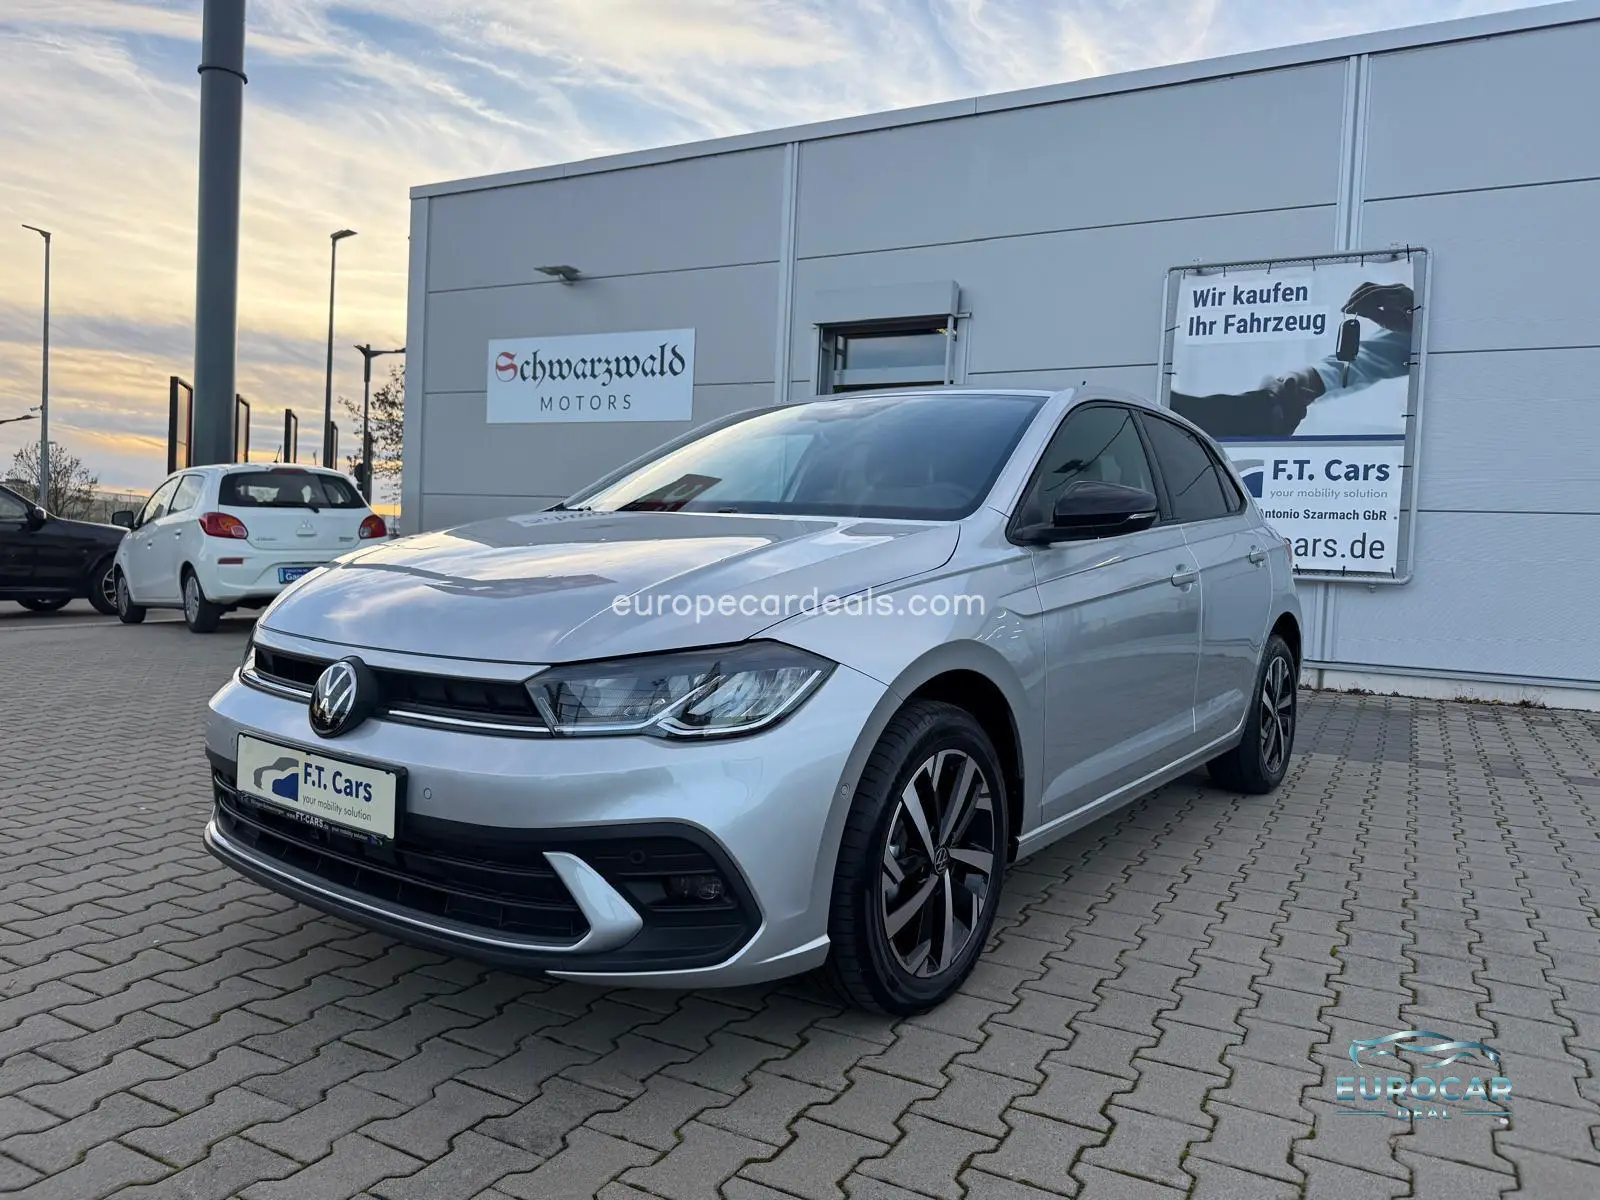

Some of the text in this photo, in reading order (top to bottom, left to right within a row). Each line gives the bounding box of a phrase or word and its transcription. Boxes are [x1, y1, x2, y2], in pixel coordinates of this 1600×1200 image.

[1193, 282, 1308, 308] Wir kaufen
[1188, 312, 1326, 336] Ihr Fahrzeug
[495, 342, 686, 388] Schwarzwald
[540, 394, 632, 411] MOTORS
[1272, 459, 1390, 482] F.T. Cars
[1270, 488, 1388, 500] your mobility solution
[1302, 509, 1360, 521] Szarmach
[1363, 510, 1387, 521] GbR
[303, 762, 373, 803] F.T. Cars
[302, 794, 372, 822] your mobility solution
